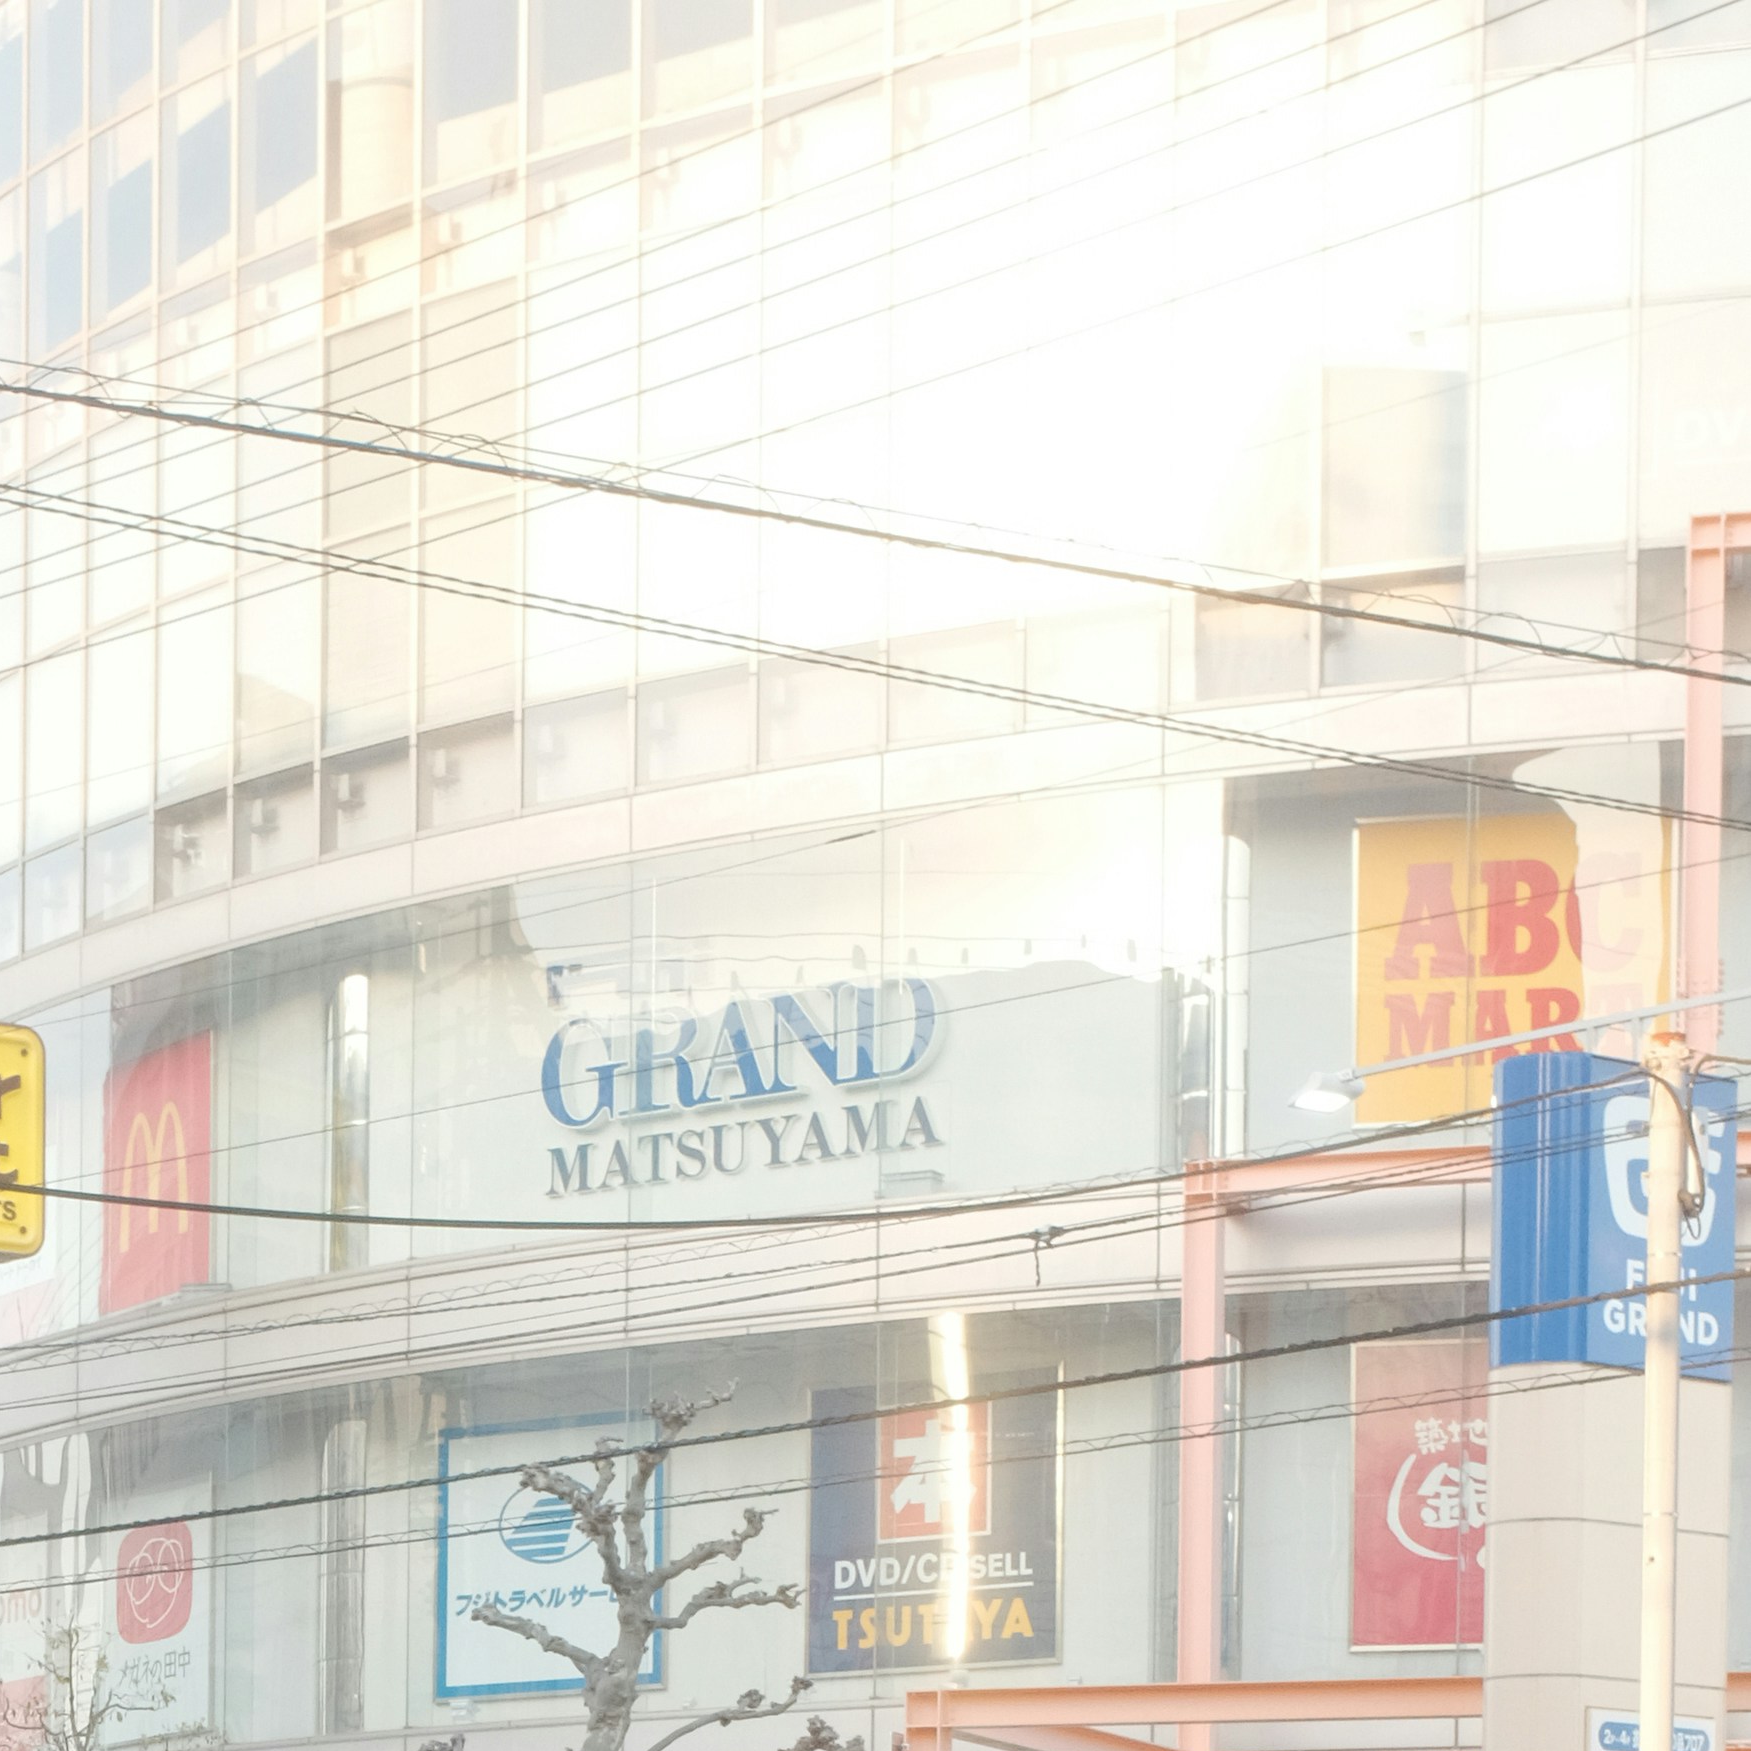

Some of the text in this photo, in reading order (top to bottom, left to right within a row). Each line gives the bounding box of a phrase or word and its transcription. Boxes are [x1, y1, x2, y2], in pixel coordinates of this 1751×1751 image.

[1384, 852, 1644, 981] ABC
[540, 976, 938, 1129] GRAND
[545, 1096, 946, 1197] MATSUYAMA
[1626, 1258, 1697, 1302] FI
[1603, 1299, 1719, 1346] GRND
[968, 1551, 1034, 1579] SELL
[832, 1597, 1035, 1650] TSUTYA
